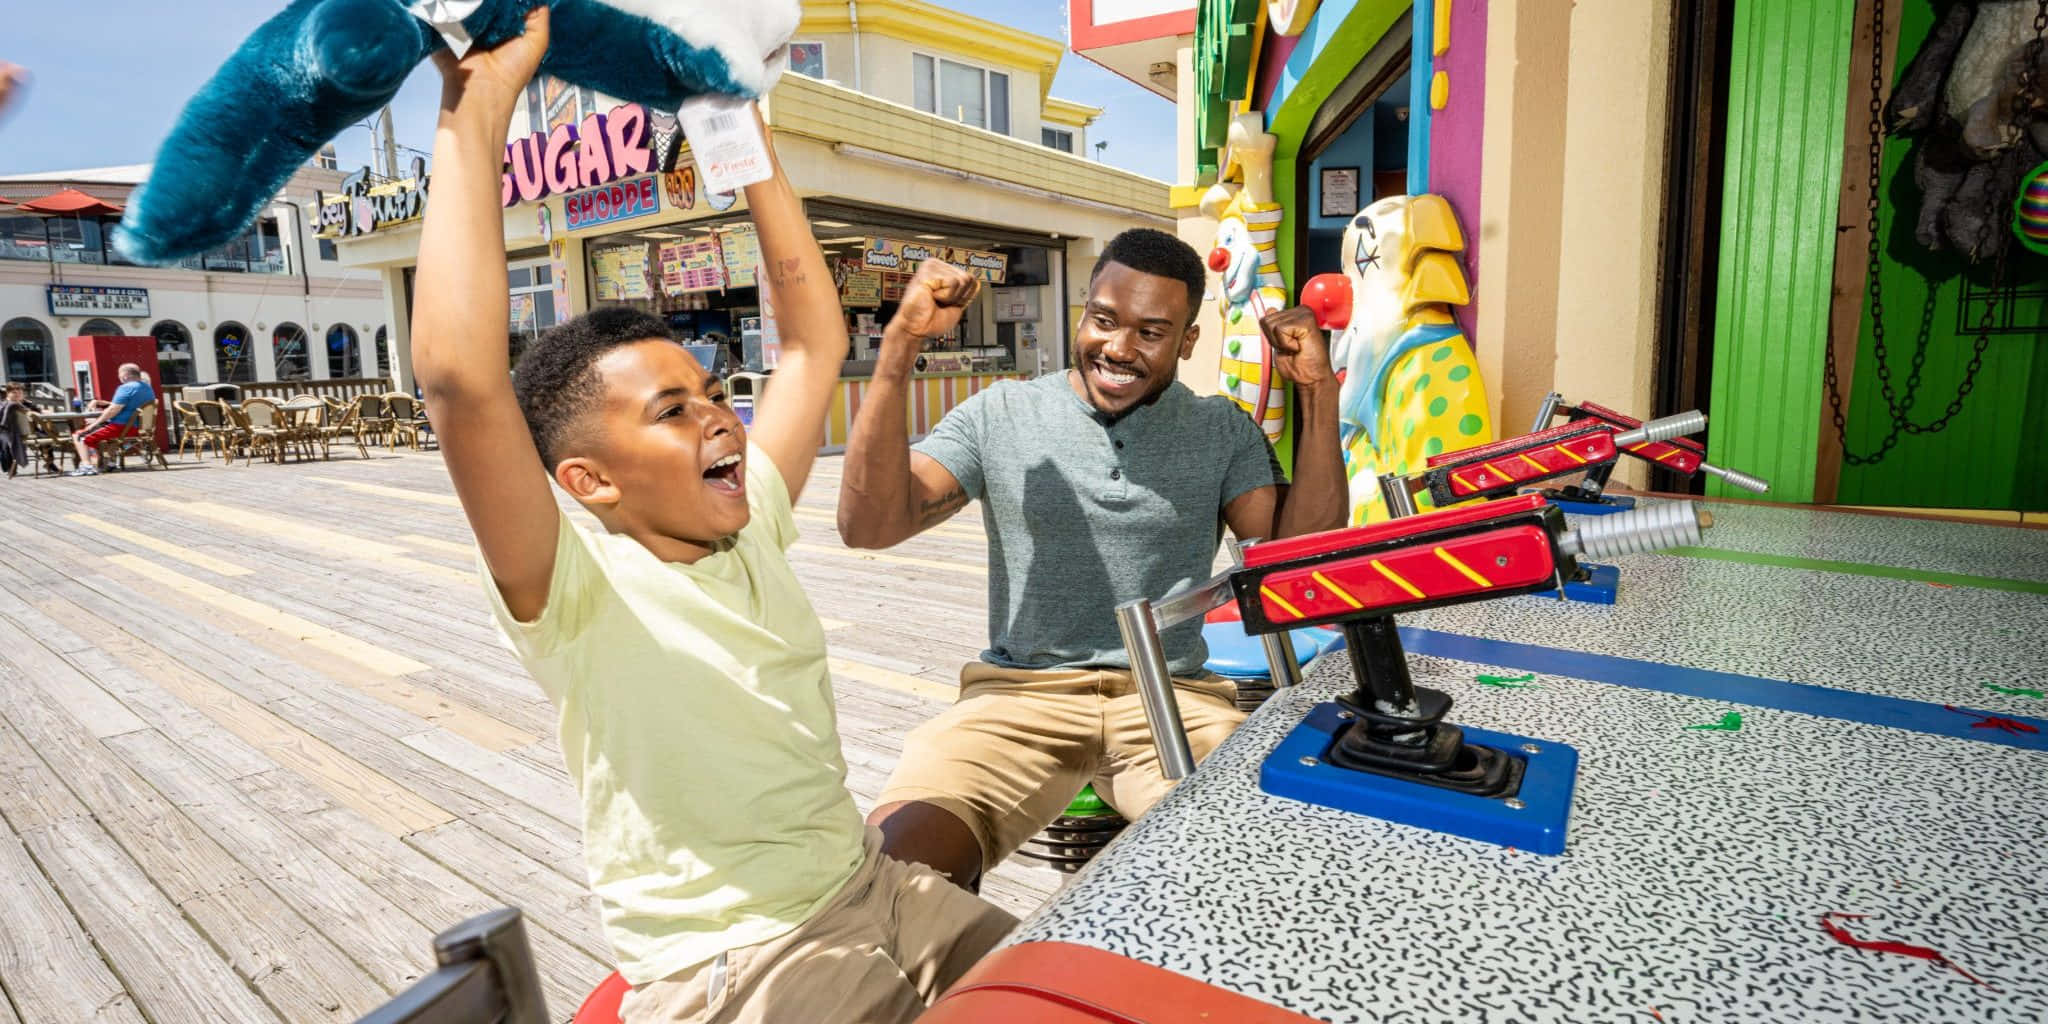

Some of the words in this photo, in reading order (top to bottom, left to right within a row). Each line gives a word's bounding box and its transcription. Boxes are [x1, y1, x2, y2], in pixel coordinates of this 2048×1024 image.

[567, 178, 654, 226] SHOPPE
[312, 189, 351, 238] Joey
[865, 250, 899, 268] Sweets
[902, 245, 931, 262] Snacks
[968, 253, 1004, 270] Smoothies
